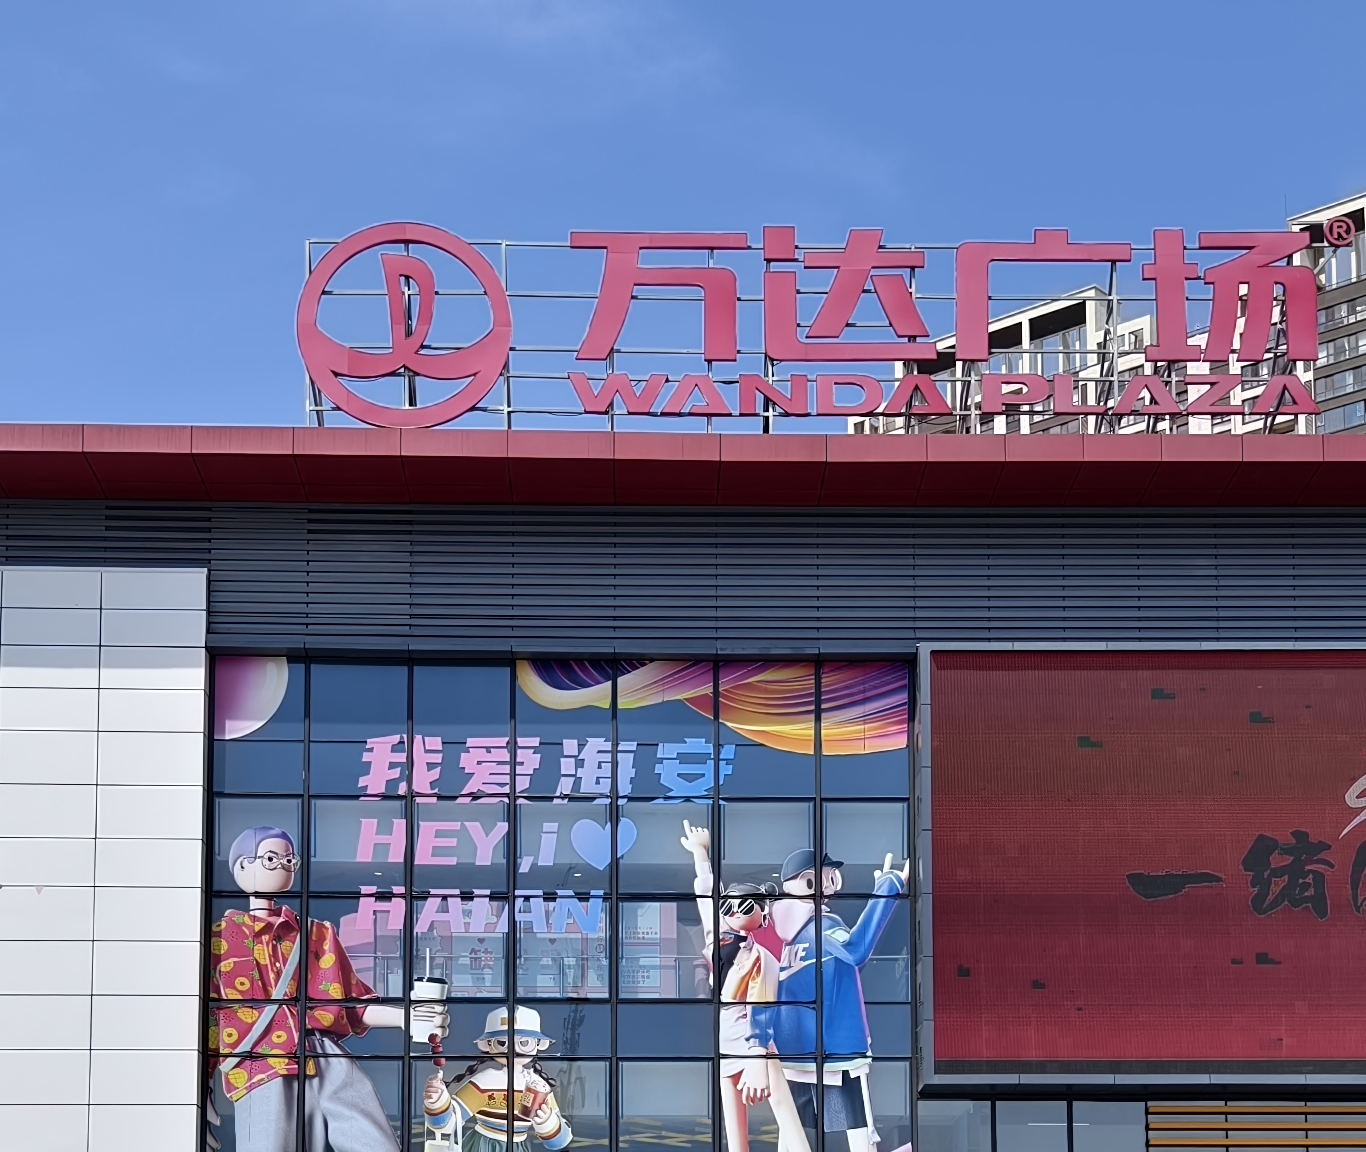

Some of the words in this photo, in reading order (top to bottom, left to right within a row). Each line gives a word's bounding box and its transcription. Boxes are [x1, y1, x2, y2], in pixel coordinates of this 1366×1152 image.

[567, 226, 1320, 363] 万达广场
[567, 371, 954, 416] WANDA
[992, 372, 1322, 416] PLAZA
[357, 734, 736, 805] 我爱海安
[354, 885, 608, 934] HAIAN
